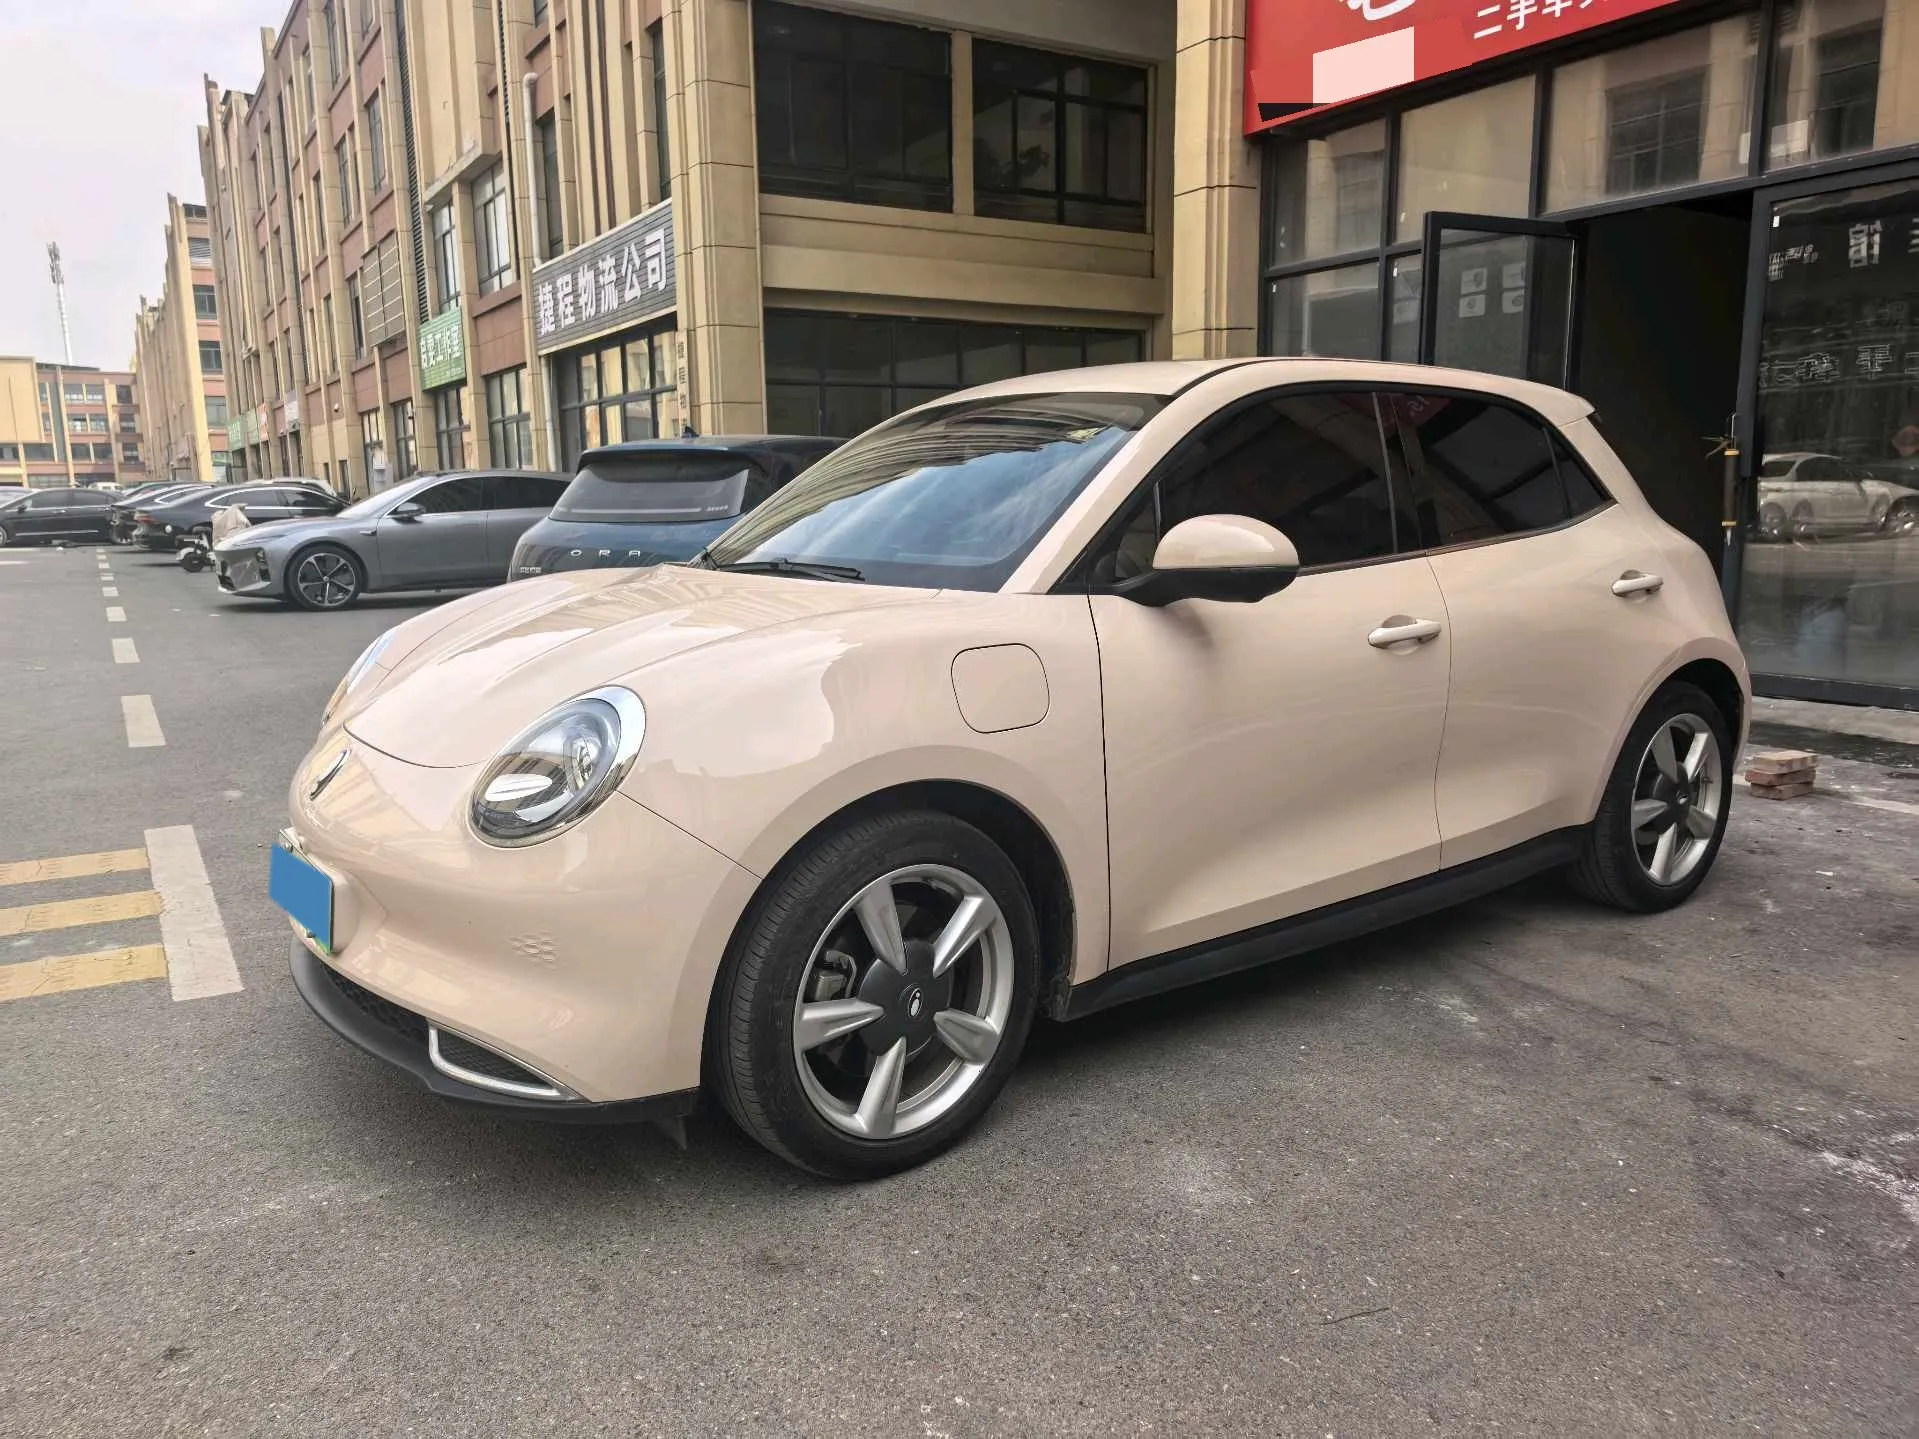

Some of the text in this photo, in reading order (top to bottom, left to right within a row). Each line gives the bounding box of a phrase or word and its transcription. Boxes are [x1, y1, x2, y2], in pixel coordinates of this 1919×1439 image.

[1473, 0, 1593, 39] 二手车
[538, 228, 667, 336] 捷程物流公司
[569, 549, 641, 558] ORA
